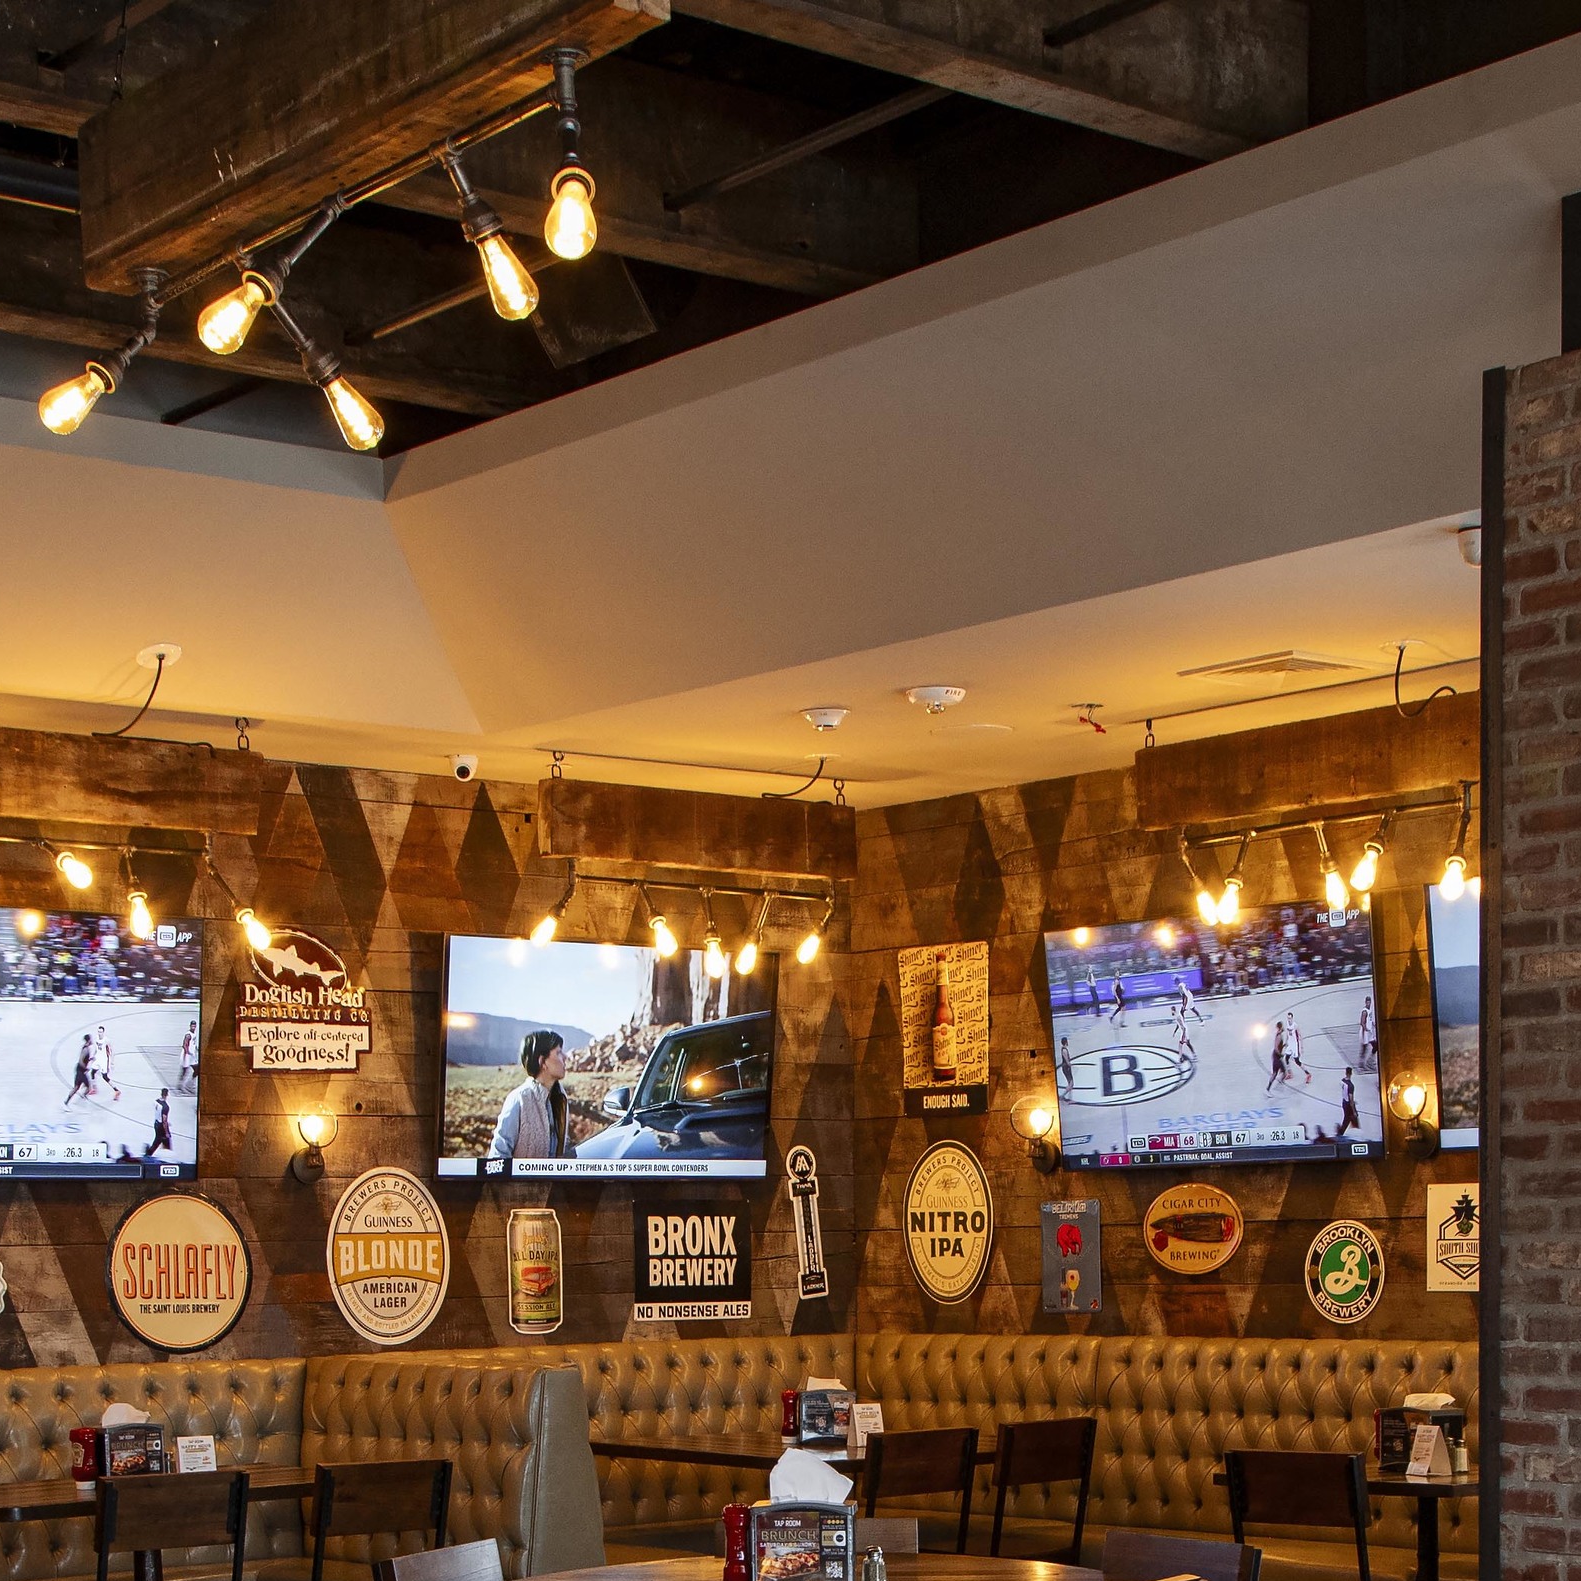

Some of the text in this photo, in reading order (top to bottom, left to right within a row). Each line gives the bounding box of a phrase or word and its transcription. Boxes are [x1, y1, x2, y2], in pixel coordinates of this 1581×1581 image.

[1317, 909, 1359, 923] THE APP
[177, 932, 192, 942] APP
[245, 983, 365, 1008] Dogfish Head
[248, 1026, 363, 1043] Explore off-centered
[262, 1043, 350, 1065] goodness!
[1101, 1054, 1144, 1096] B
[923, 1093, 969, 1109] ENOUGH SAID.
[1159, 1107, 1284, 1128] BARCLAYS
[1164, 1137, 1175, 1147] MIA
[1183, 1136, 1195, 1145] 68
[1216, 1134, 1227, 1144] BKN
[1236, 1133, 1246, 1143] 67
[1270, 1131, 1285, 1140] :26.3
[19, 1147, 32, 1157] 67
[63, 1147, 82, 1157] :26.3
[92, 1149, 99, 1157] 18
[1173, 1153, 1200, 1161] PASTRNAK:
[1215, 1152, 1233, 1160] ASSIST
[519, 1164, 554, 1172] COMING
[557, 1164, 568, 1172] UP
[575, 1164, 602, 1172] STEPHEN
[615, 1164, 627, 1172] TOP
[633, 1164, 652, 1172] SUPER
[653, 1164, 670, 1172] BOWL
[671, 1164, 708, 1172] CONTENDERS
[916, 1155, 980, 1196] BREWERS PROJECT
[344, 1179, 432, 1223] BREWERS PROJECT
[926, 1194, 968, 1209] GUINNESS
[1162, 1198, 1220, 1209] CIGAR CITY
[364, 1214, 413, 1228] GUINNESS
[910, 1210, 986, 1234] NITRO
[647, 1215, 738, 1256] BRONX
[1315, 1227, 1374, 1255] BROOKLYN
[930, 1238, 965, 1258] IPA
[1439, 1242, 1464, 1256] SOUTH
[338, 1239, 441, 1278] BLONDE
[513, 1250, 558, 1261] ALL DAY IPA
[1169, 1251, 1218, 1261] BREWING
[122, 1242, 237, 1300] SCHLAFLY
[648, 1258, 738, 1287] BREWERY
[362, 1282, 418, 1295] AMERICAN
[139, 1304, 219, 1314] THE SAINT LOUIS BREWERY
[373, 1297, 408, 1308] LAGER
[1315, 1291, 1372, 1317] BREWERY
[637, 1304, 749, 1318] NO NONSENSE ALES
[761, 1530, 816, 1540] BRUNCH
